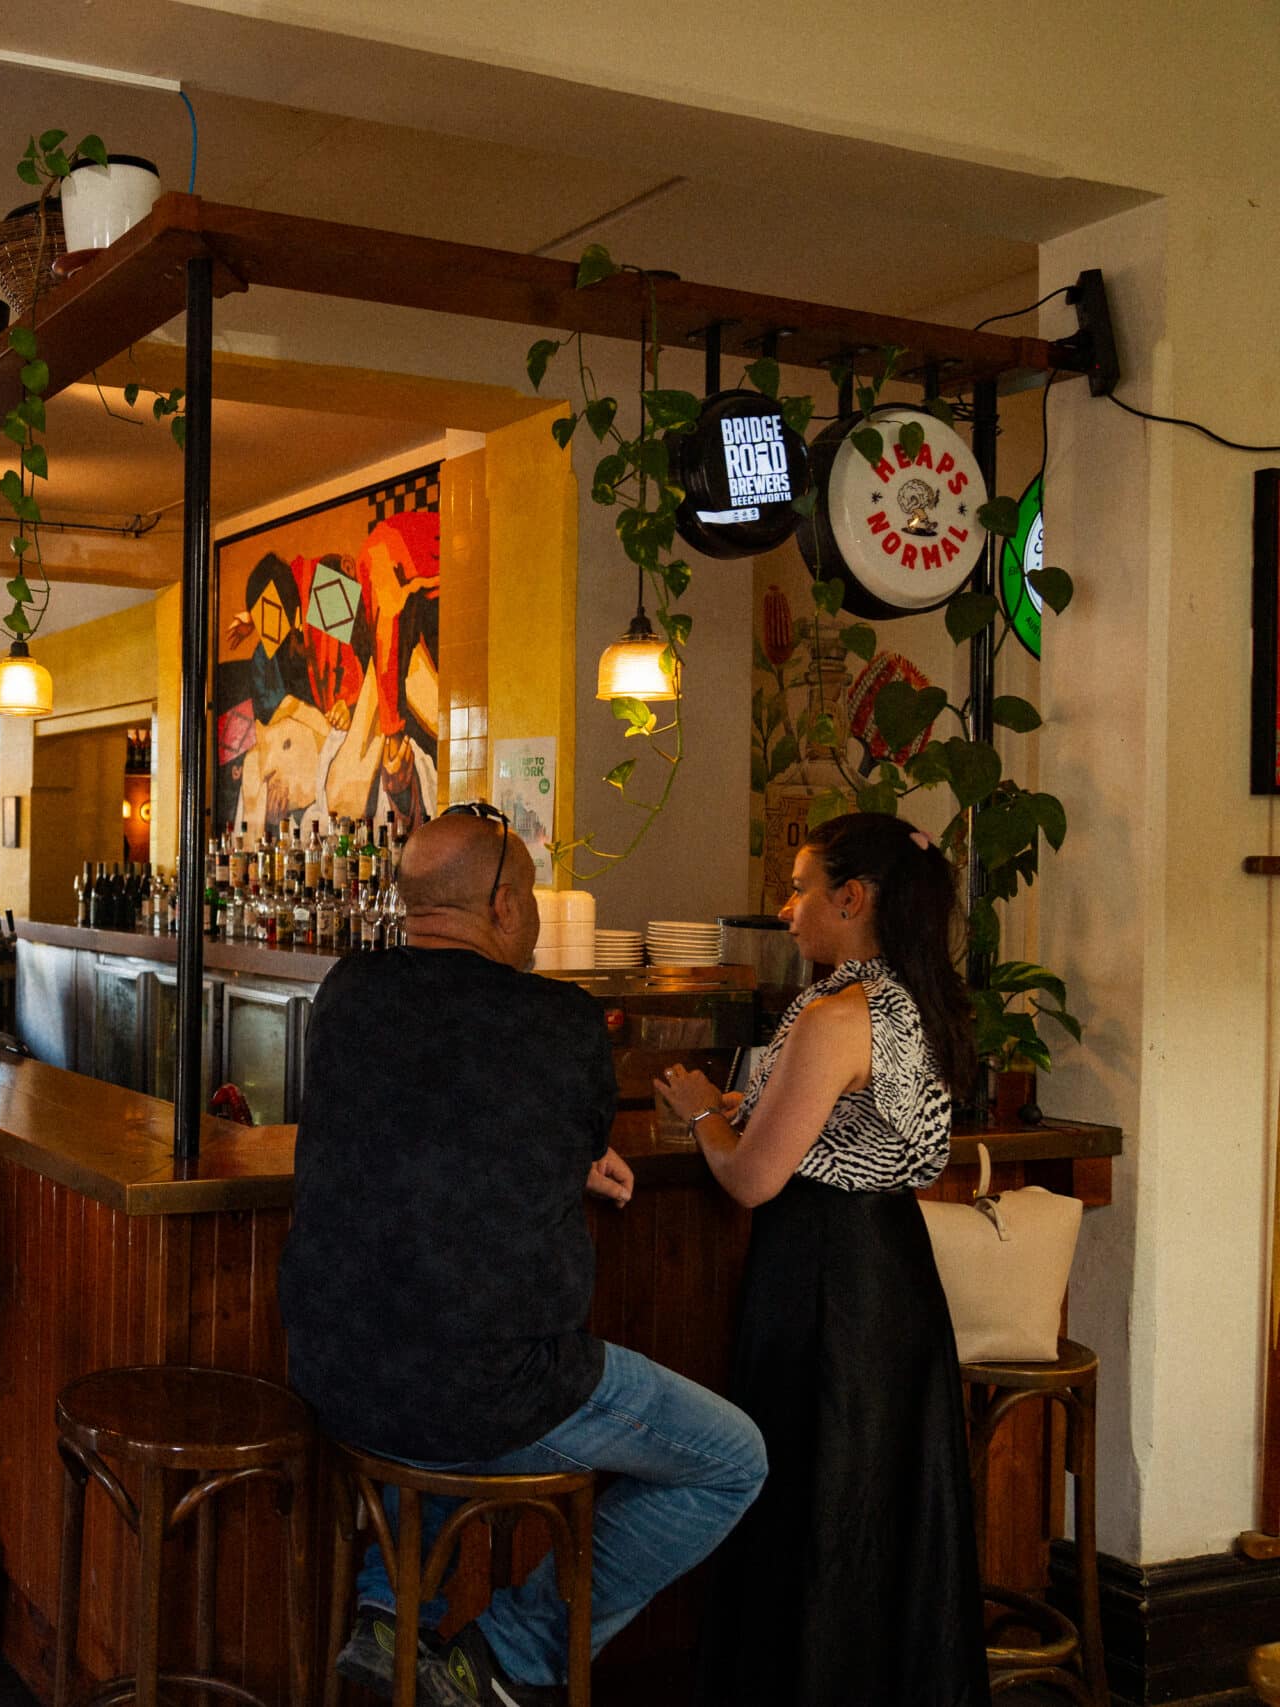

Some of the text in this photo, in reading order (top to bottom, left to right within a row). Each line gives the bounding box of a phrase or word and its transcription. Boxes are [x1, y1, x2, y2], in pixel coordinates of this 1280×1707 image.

[720, 415, 783, 444] BRIDGE
[724, 440, 787, 478] ROAD
[870, 442, 969, 495] HEAPS
[728, 473, 790, 497] BREWERS
[731, 492, 791, 506] BEECHWORTH
[867, 511, 969, 571] NORMAL
[535, 757, 545, 766] TO
